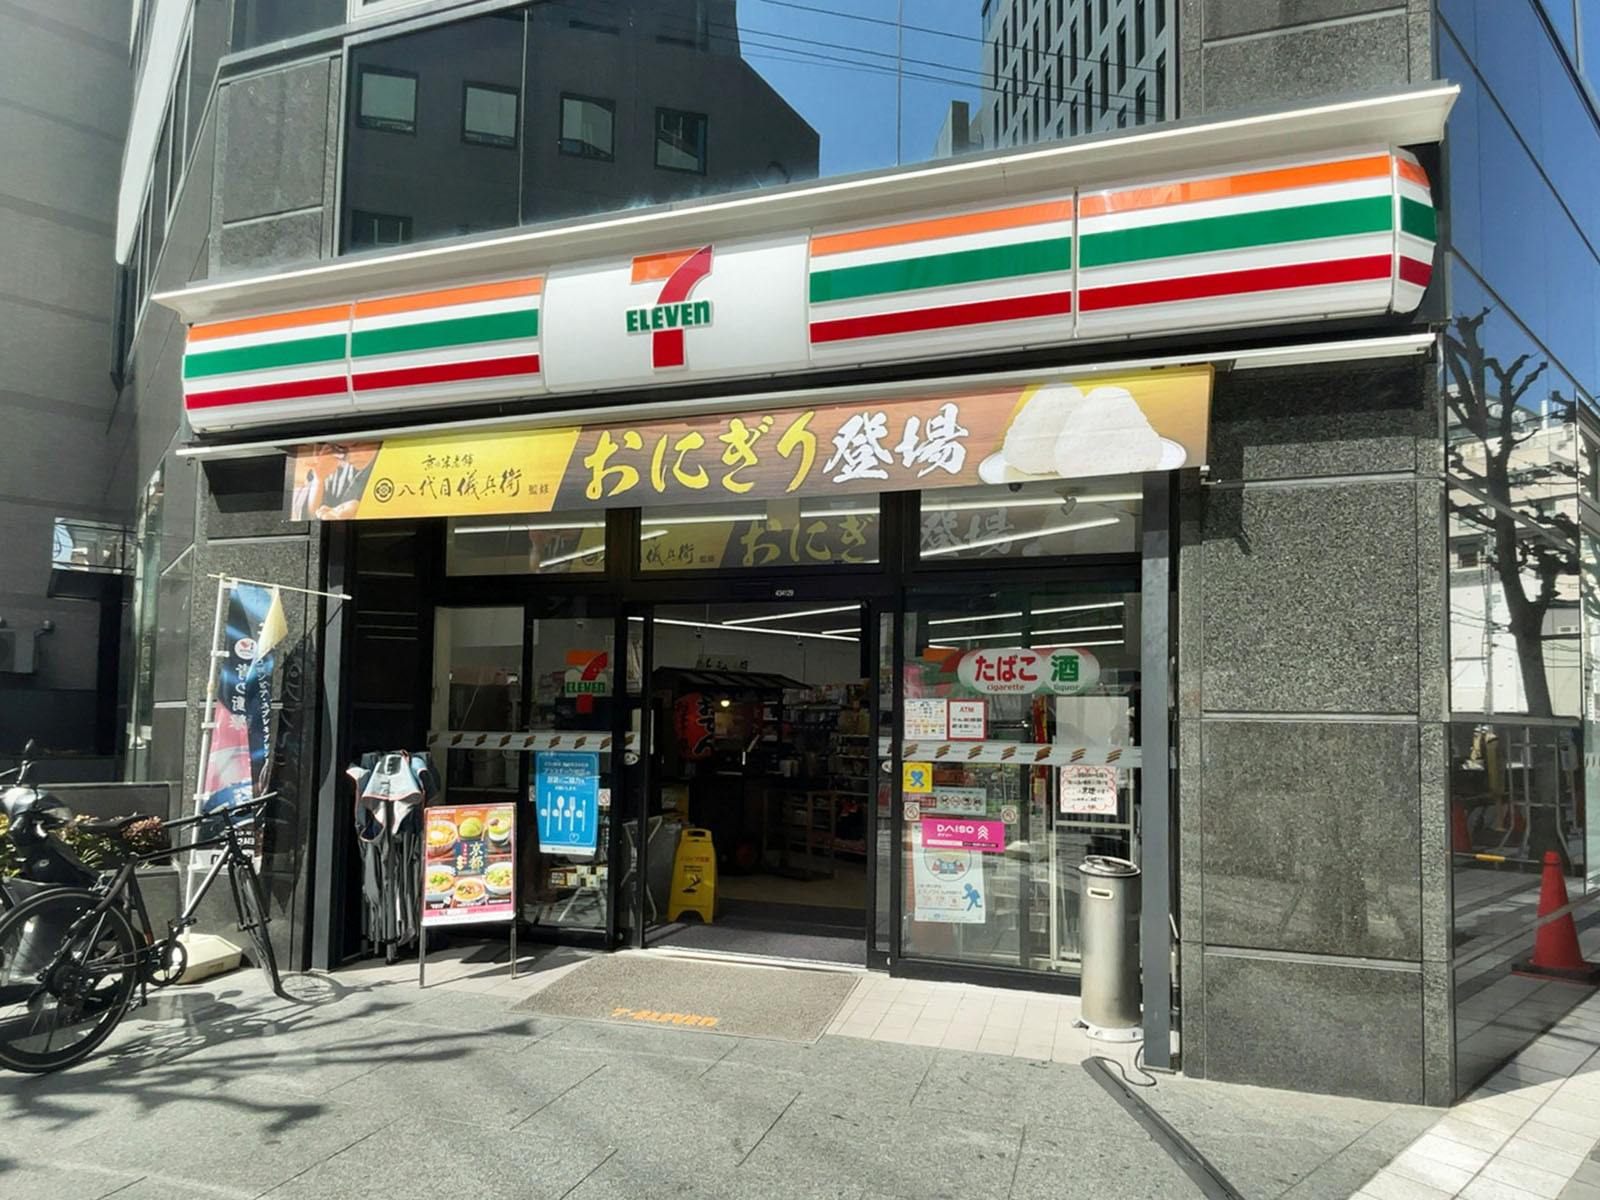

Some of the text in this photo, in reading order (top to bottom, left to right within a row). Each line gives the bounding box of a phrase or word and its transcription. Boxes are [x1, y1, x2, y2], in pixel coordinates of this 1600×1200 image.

[584, 403, 969, 500] おにぎり登場
[974, 655, 1079, 682] たばこ 酒
[986, 683, 1080, 692] cigarette liquor
[936, 823, 975, 834] DAISO
